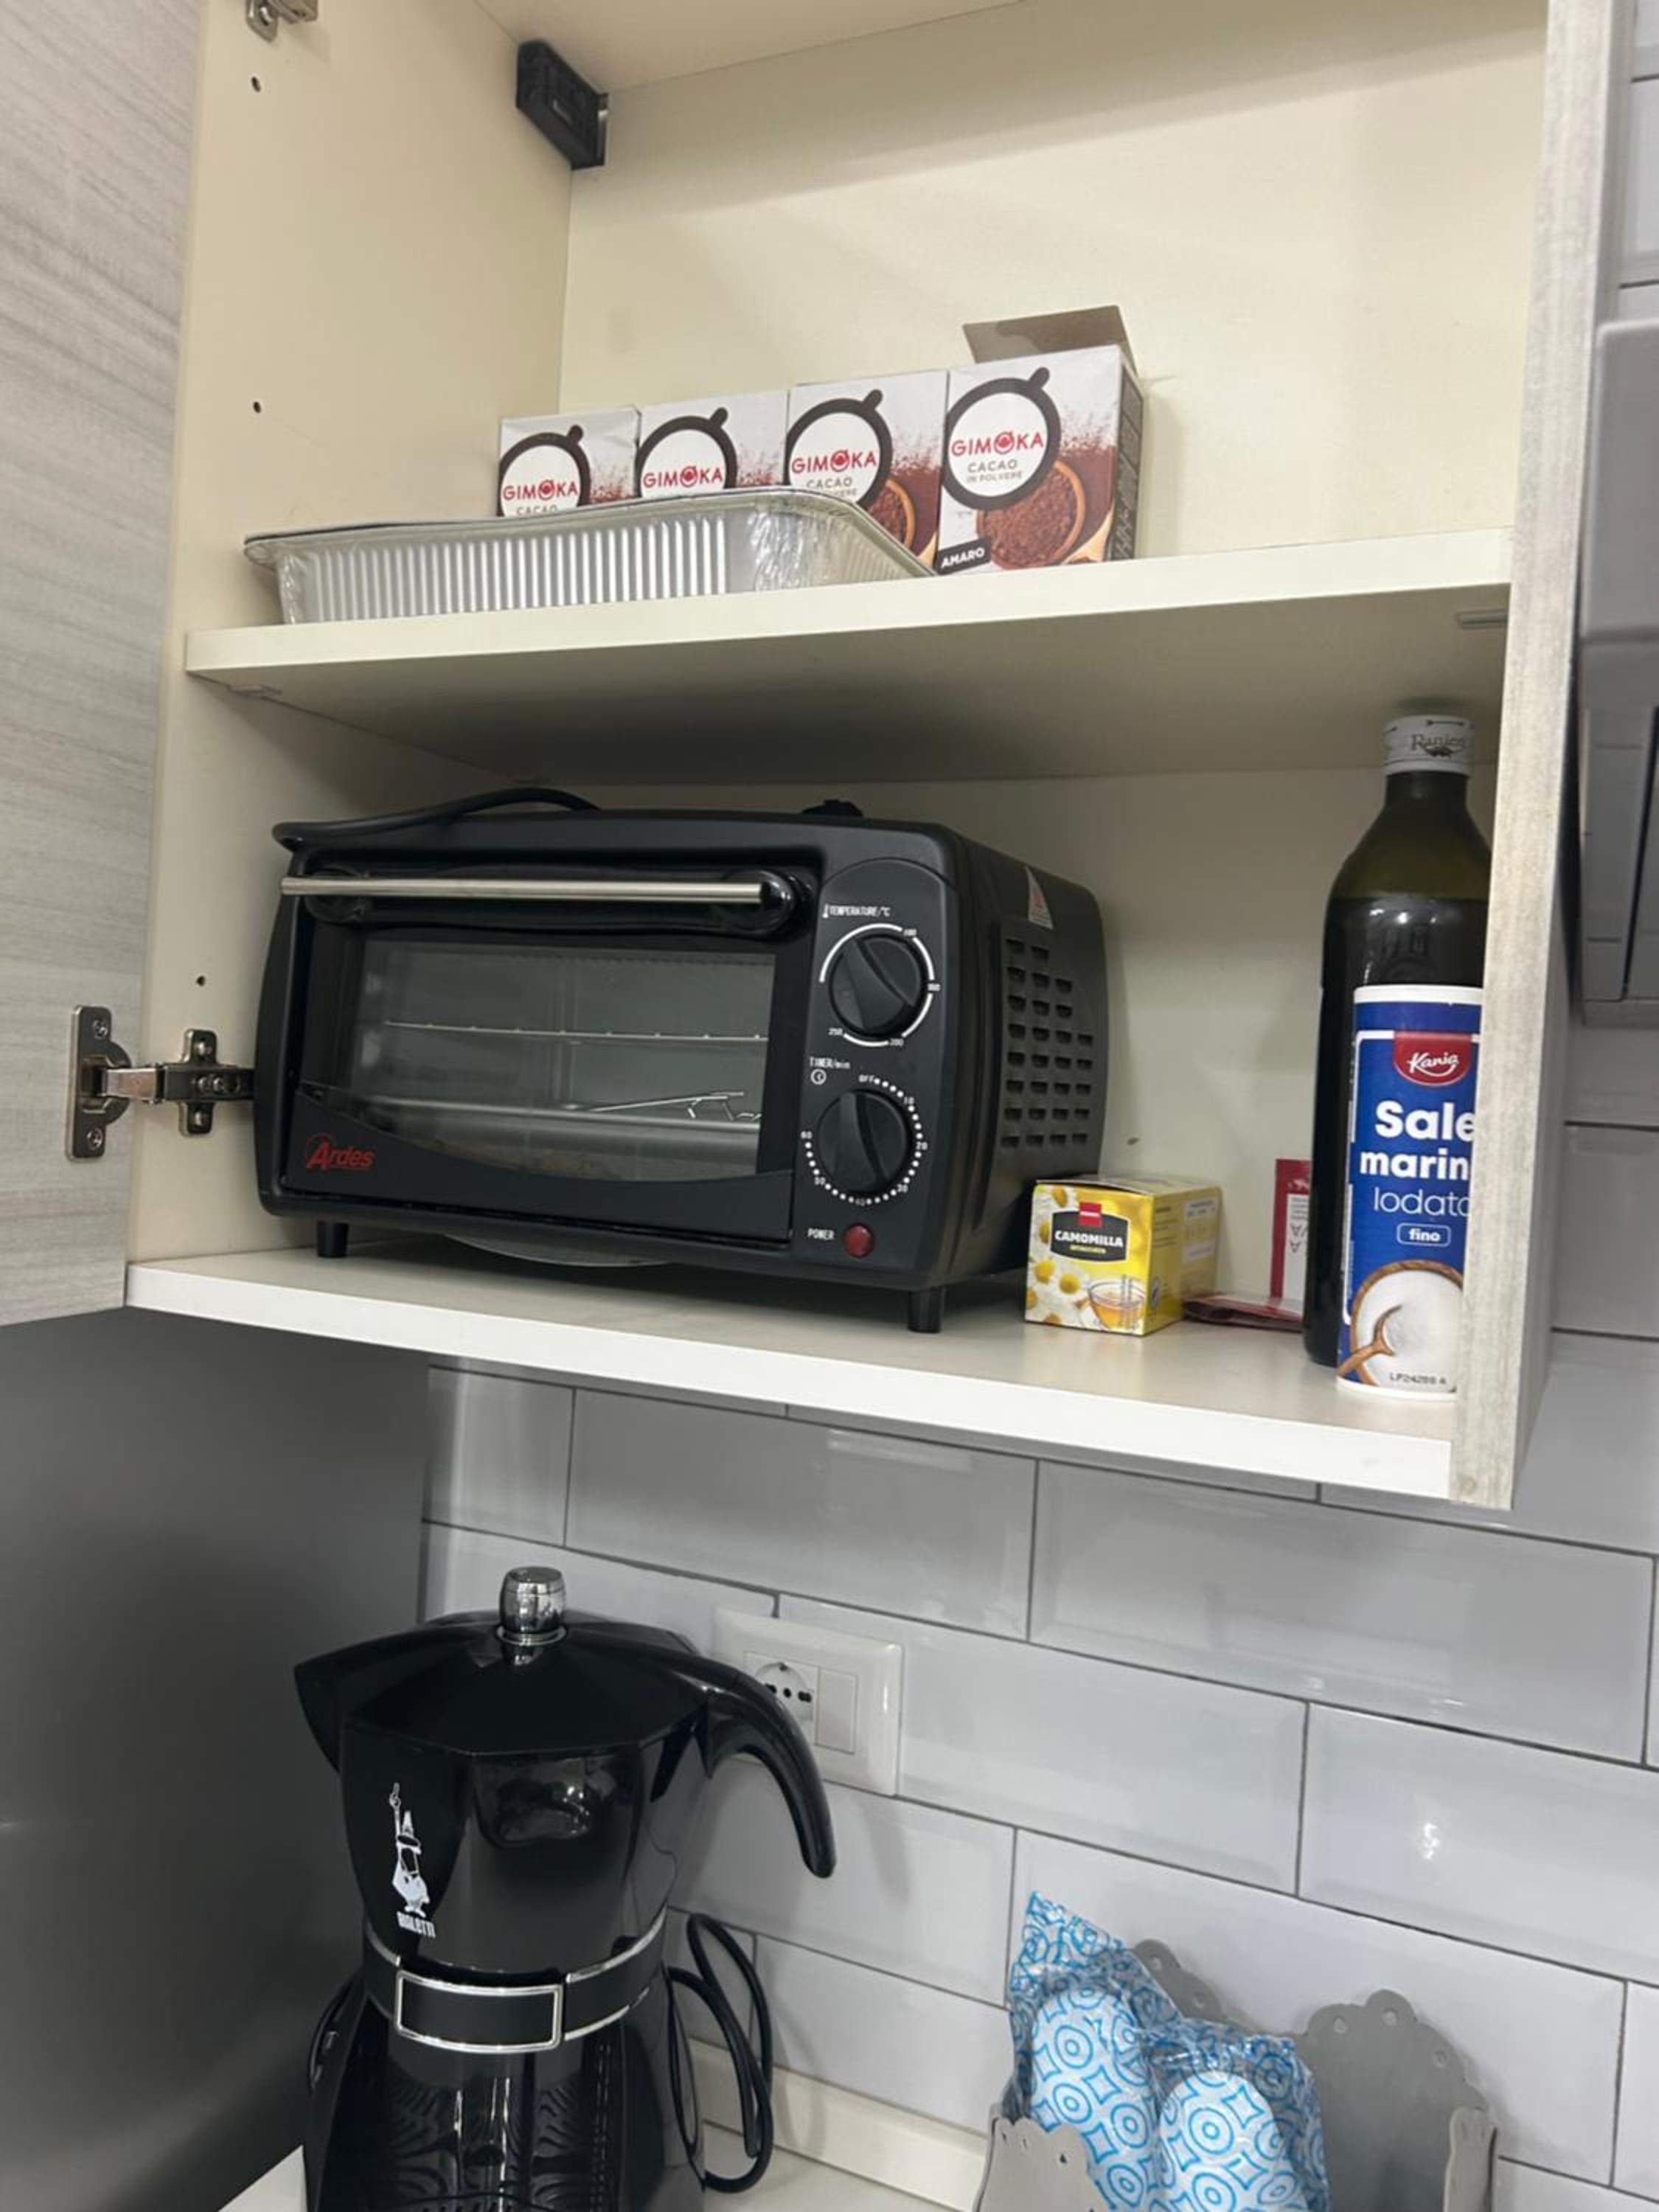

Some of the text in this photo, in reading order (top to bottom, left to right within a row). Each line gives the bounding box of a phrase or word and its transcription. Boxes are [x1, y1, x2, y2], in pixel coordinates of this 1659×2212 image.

[951, 430, 1043, 456] GIMOKA
[791, 450, 877, 473] GIMOKA
[967, 459, 1018, 473] CACAO
[643, 466, 723, 487] GIMOKA
[806, 478, 852, 489] CACAO
[502, 480, 578, 501] GIMOKA
[941, 547, 985, 568] AMARO
[1407, 1051, 1459, 1077] Kania
[1375, 1100, 1475, 1141] Sale
[306, 1141, 376, 1170] Ardes
[1360, 1147, 1470, 1180] marin
[807, 1228, 835, 1240] POWER
[1054, 1230, 1124, 1248] CAMOMILLA
[1408, 1228, 1440, 1242] fino
